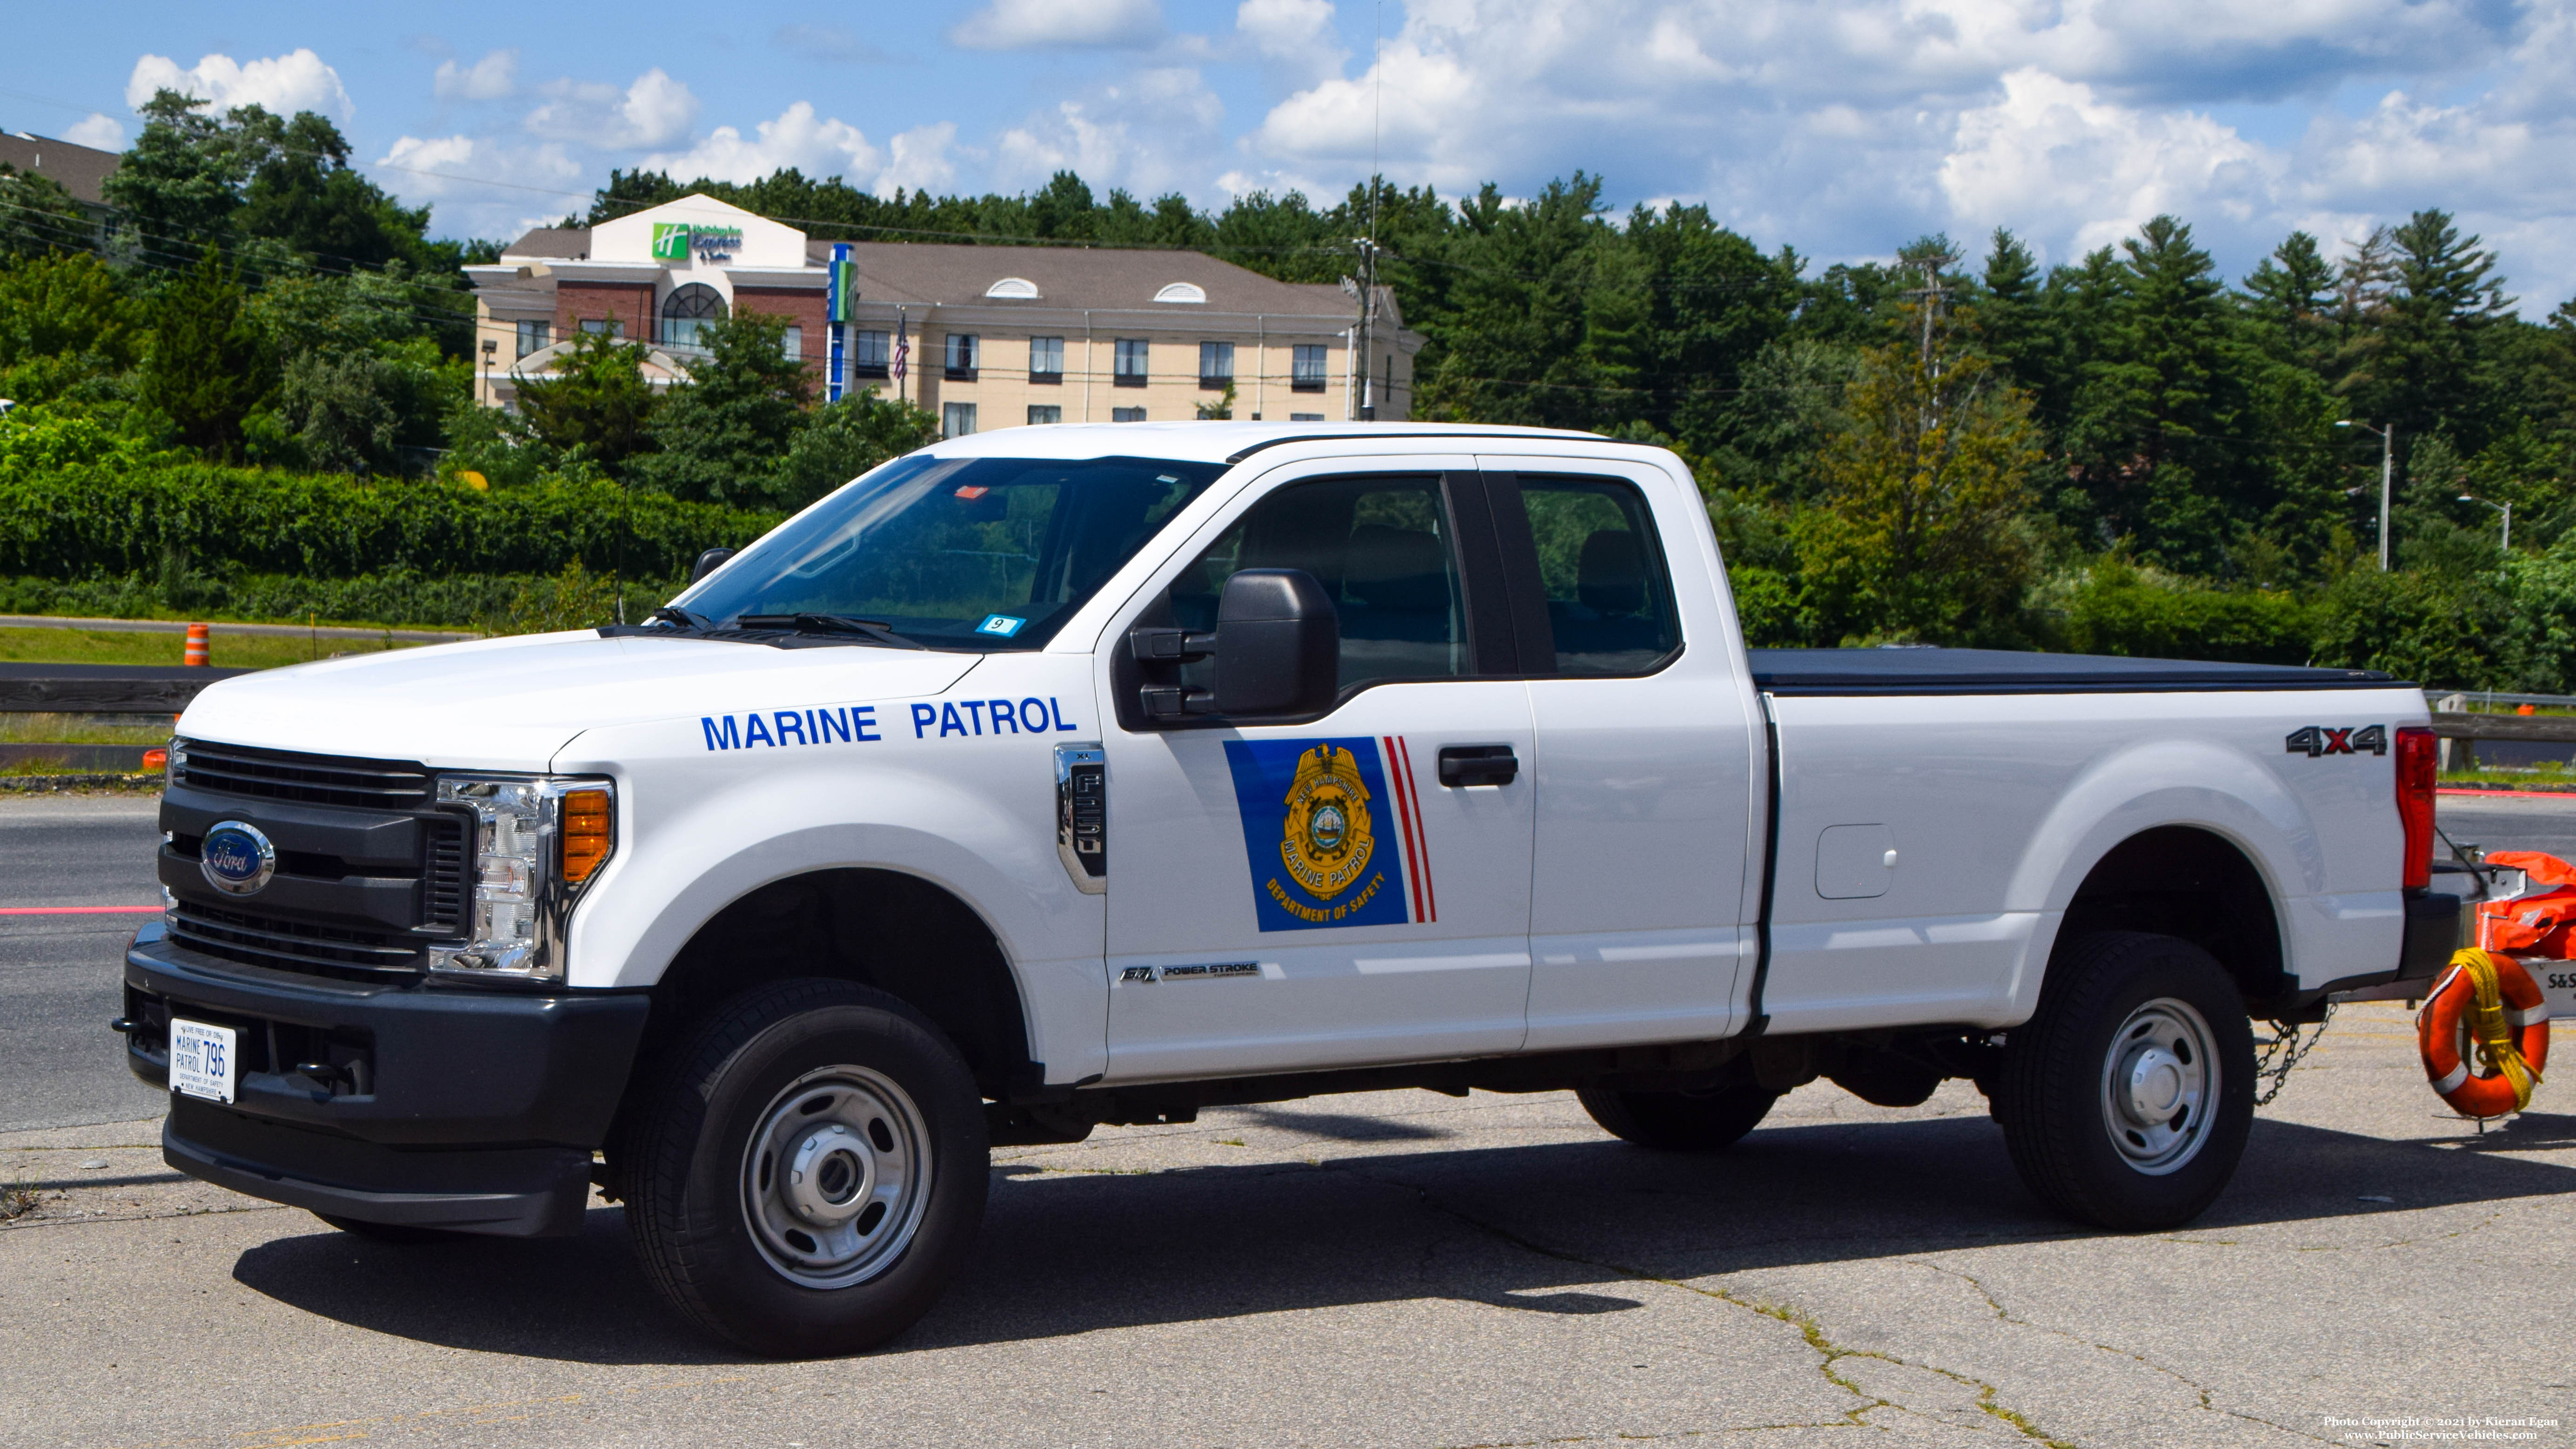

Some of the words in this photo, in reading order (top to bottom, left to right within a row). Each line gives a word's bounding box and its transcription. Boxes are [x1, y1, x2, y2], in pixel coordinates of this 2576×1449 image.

[692, 234, 742, 249] Express
[991, 619, 1004, 629] 9
[701, 706, 881, 751] MARINE
[911, 697, 1077, 739] PATROL
[1297, 784, 1312, 804] NEW
[1313, 775, 1359, 802] HAMPSHIRE
[214, 838, 248, 872] Ford
[1284, 839, 1323, 887] MARINE
[1330, 838, 1370, 886] PATROL
[1266, 877, 1331, 922] DEPARTMENT
[1334, 904, 1347, 920] OF
[1350, 871, 1385, 912] SAFETY
[1164, 966, 1206, 975] POWER
[1210, 963, 1258, 973] STROKE
[195, 1028, 205, 1036] FREE
[176, 1035, 201, 1055] MARINE
[176, 1053, 201, 1073] PATROL
[203, 1040, 226, 1078] 796
[180, 1073, 202, 1083] DEPARTMENT
[210, 1079, 223, 1088] SAFETY
[195, 1085, 217, 1095] HAMPSHIRE
